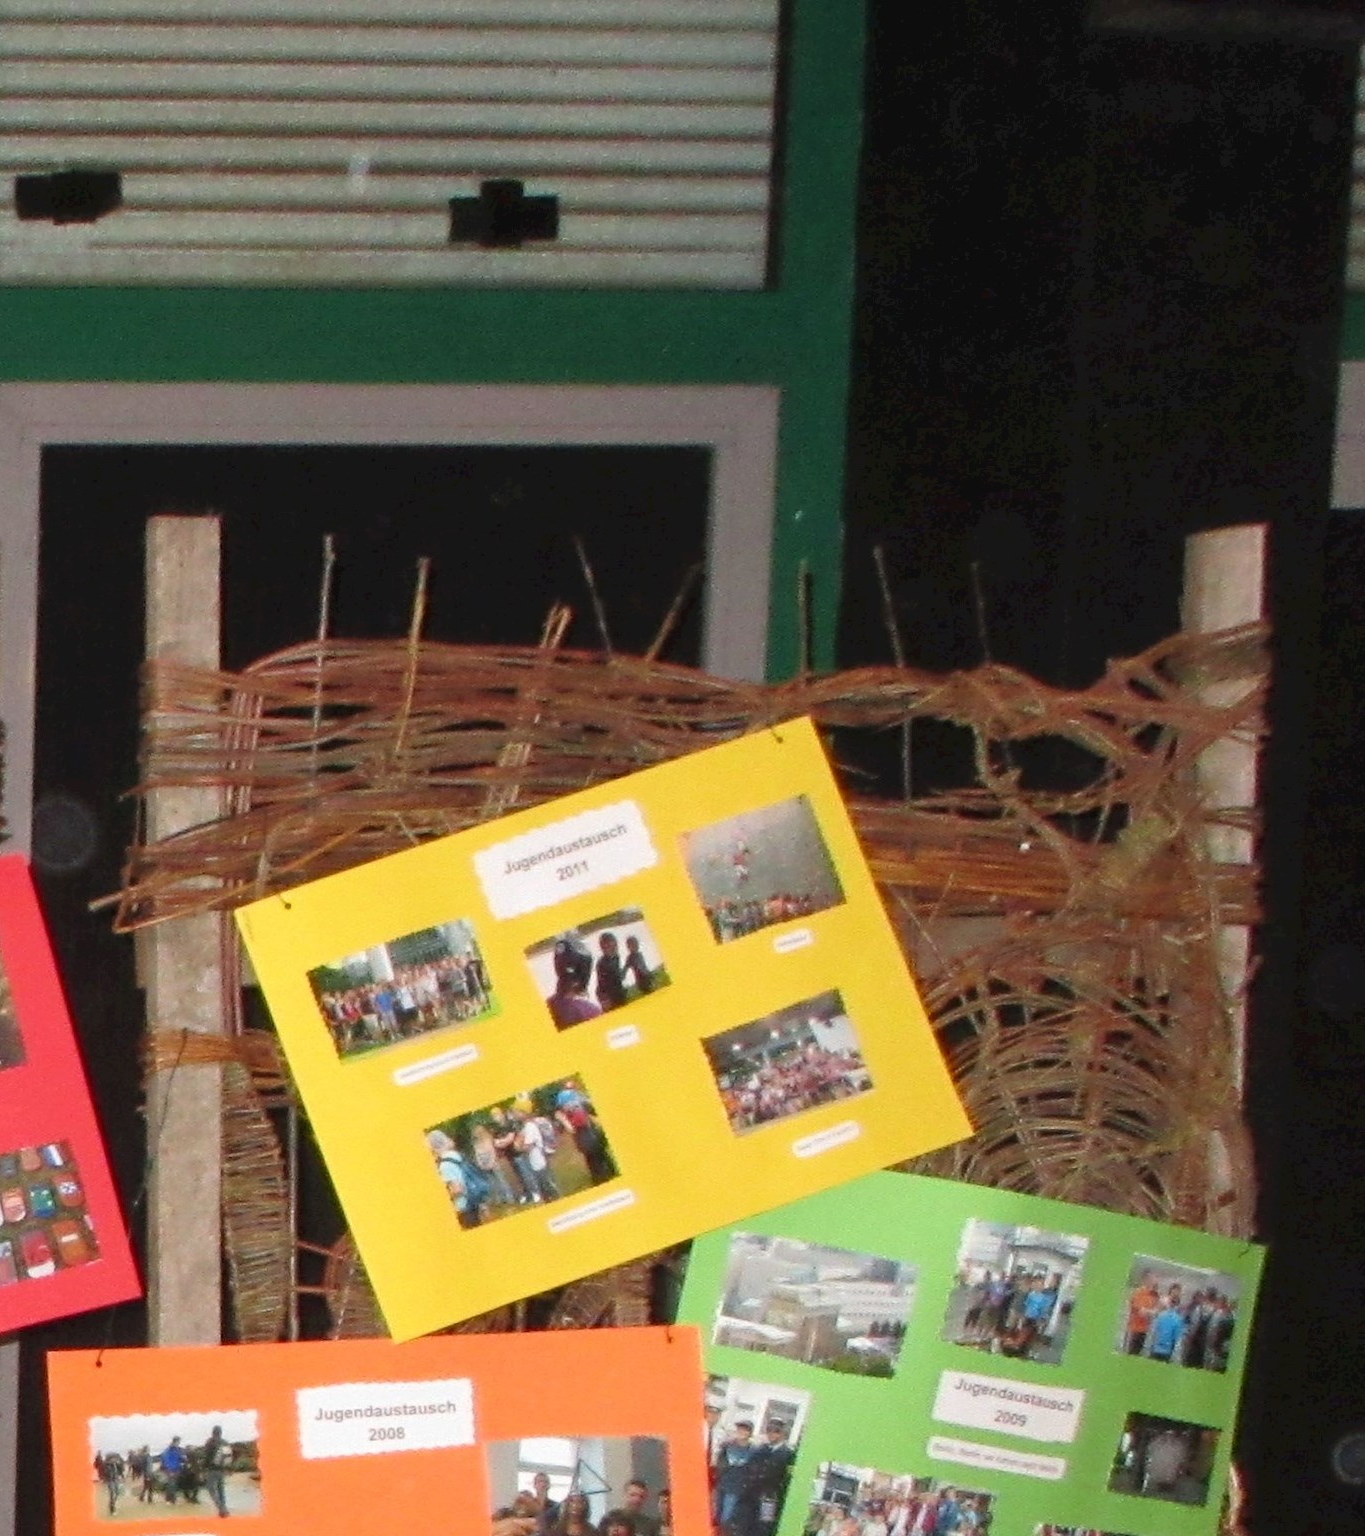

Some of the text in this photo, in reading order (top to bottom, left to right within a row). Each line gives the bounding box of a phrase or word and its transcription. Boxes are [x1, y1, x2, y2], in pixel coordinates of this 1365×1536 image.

[504, 824, 627, 875] Jugendaustausch
[556, 860, 589, 881] 2011
[954, 1379, 1074, 1413] Jugendaustausch
[315, 1401, 457, 1423] Jugendaustausch
[994, 1410, 1027, 1427] 2009
[369, 1427, 406, 1441] 2008
